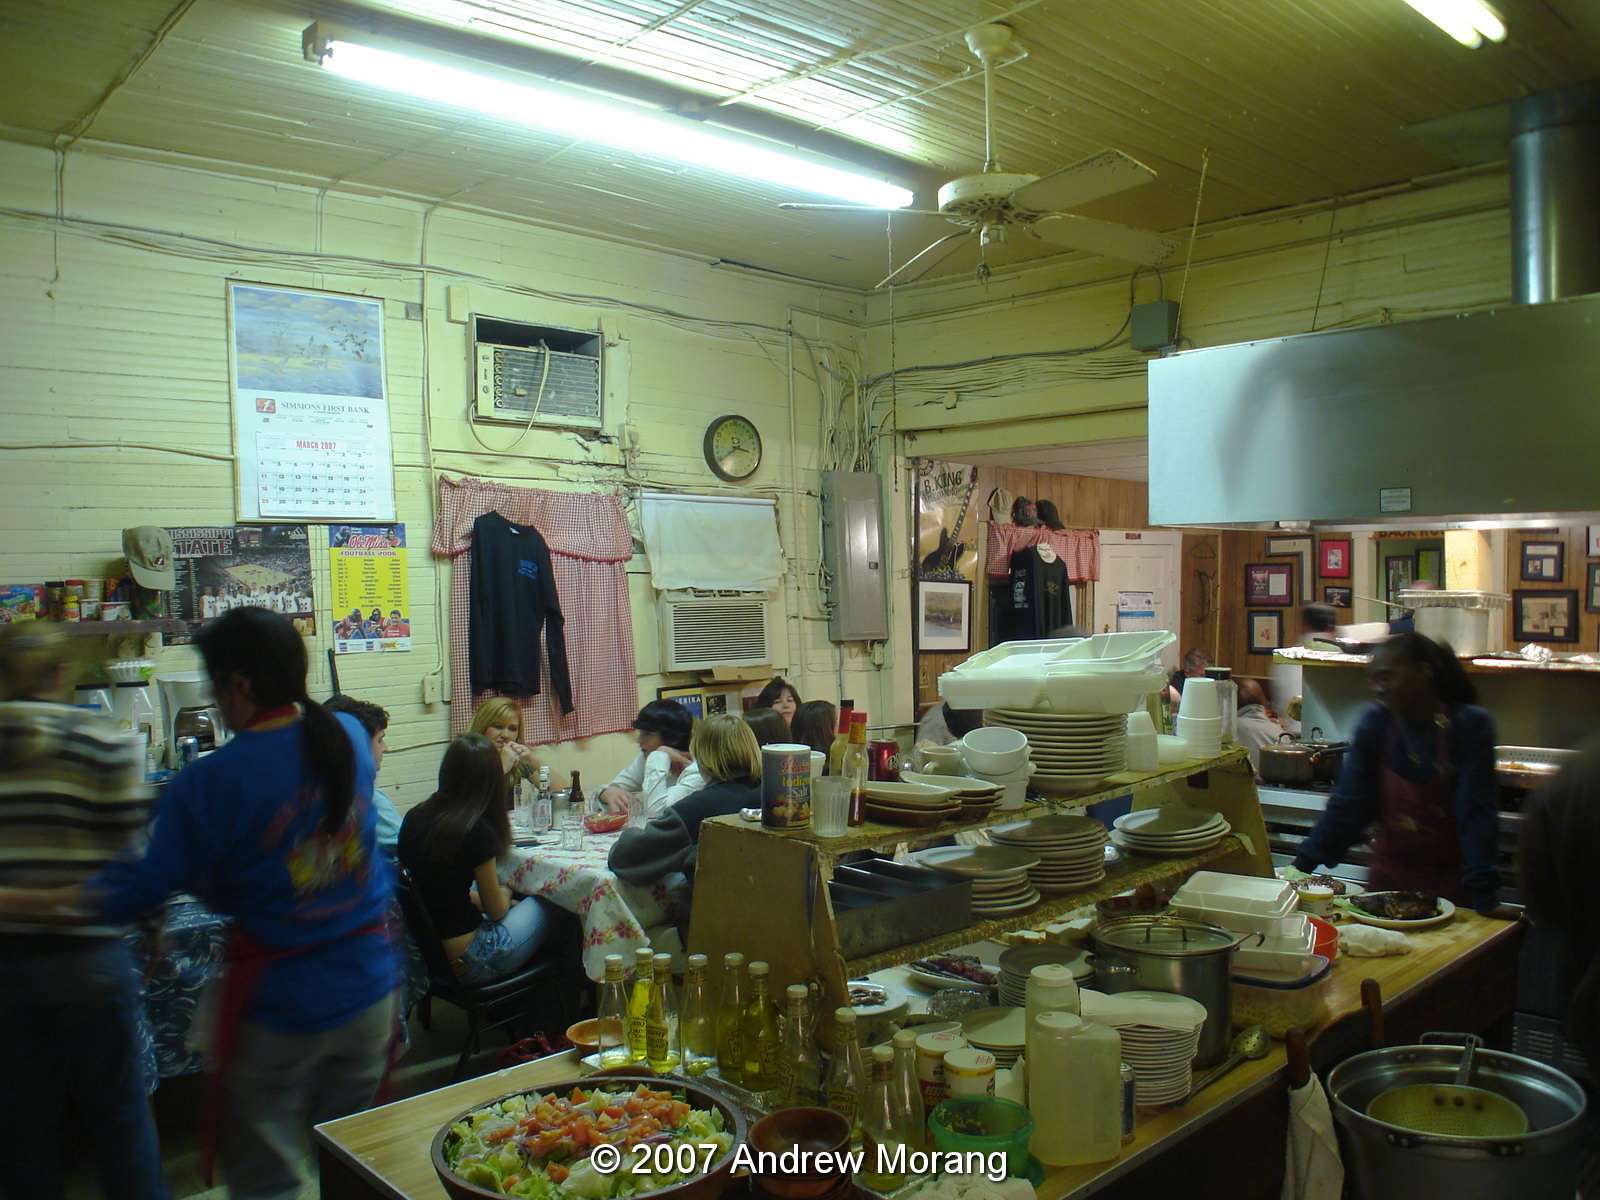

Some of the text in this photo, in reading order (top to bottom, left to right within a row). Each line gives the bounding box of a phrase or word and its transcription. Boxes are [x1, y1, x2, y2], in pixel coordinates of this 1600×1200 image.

[281, 402, 321, 411] SIMMONS
[323, 404, 345, 413] FIRST
[348, 406, 370, 414] BANK
[296, 440, 337, 450] MARCH 2007
[166, 528, 234, 539] ISSISSIPPI
[172, 539, 233, 556] TATE
[348, 534, 390, 551] Ole Miss
[792, 785, 808, 798] Salt
